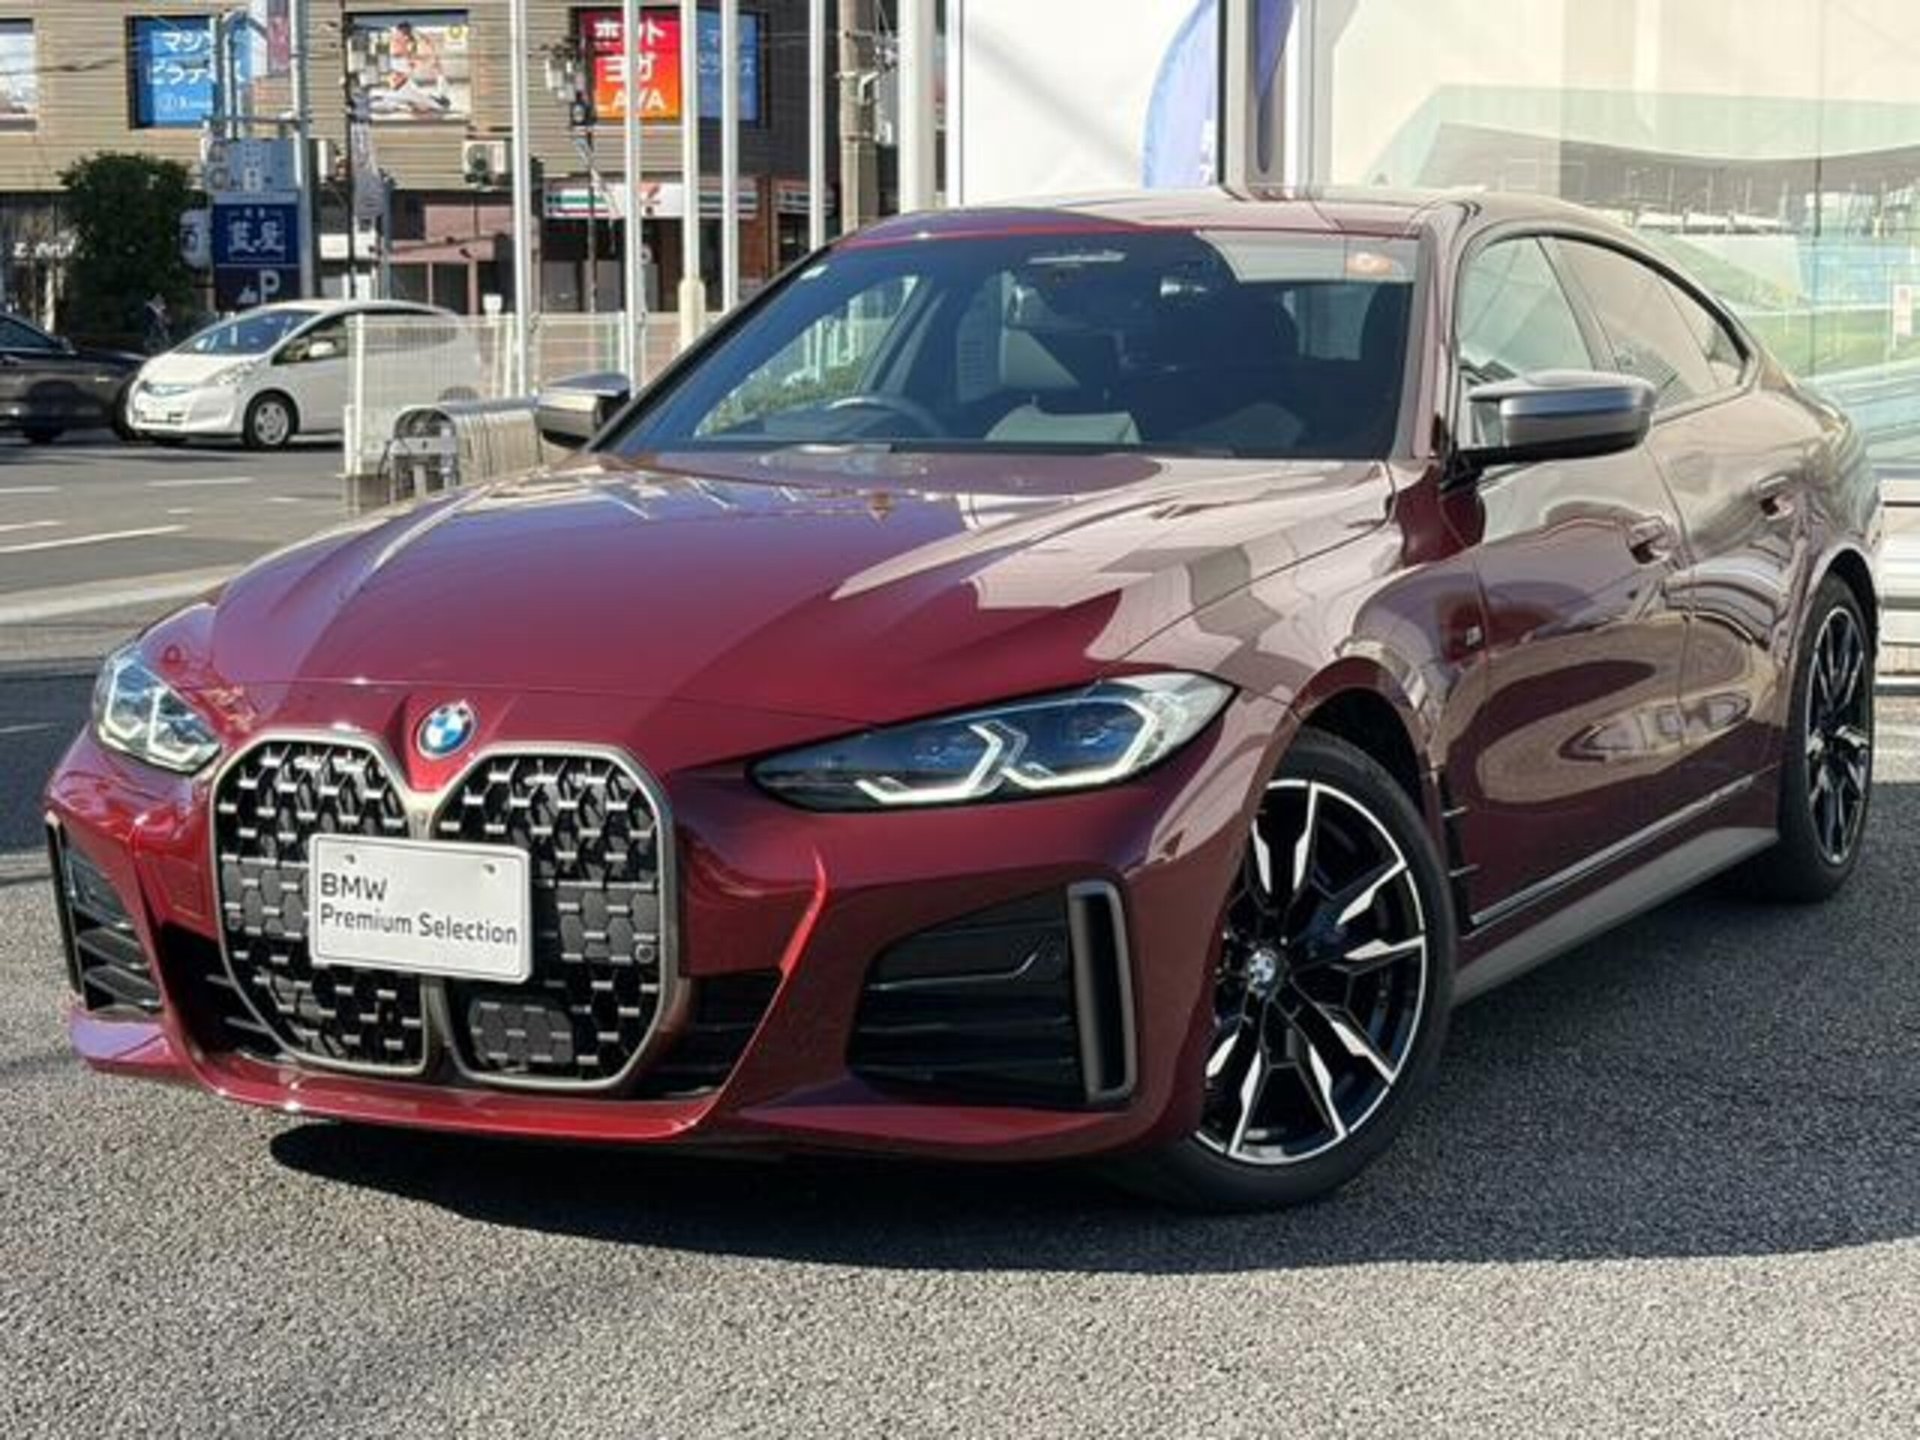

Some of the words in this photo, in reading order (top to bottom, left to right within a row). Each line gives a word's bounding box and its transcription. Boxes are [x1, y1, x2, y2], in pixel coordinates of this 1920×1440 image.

[259, 270, 281, 303] P
[320, 872, 388, 900] BMW
[320, 903, 413, 935] Premium
[419, 912, 517, 945] Selection
